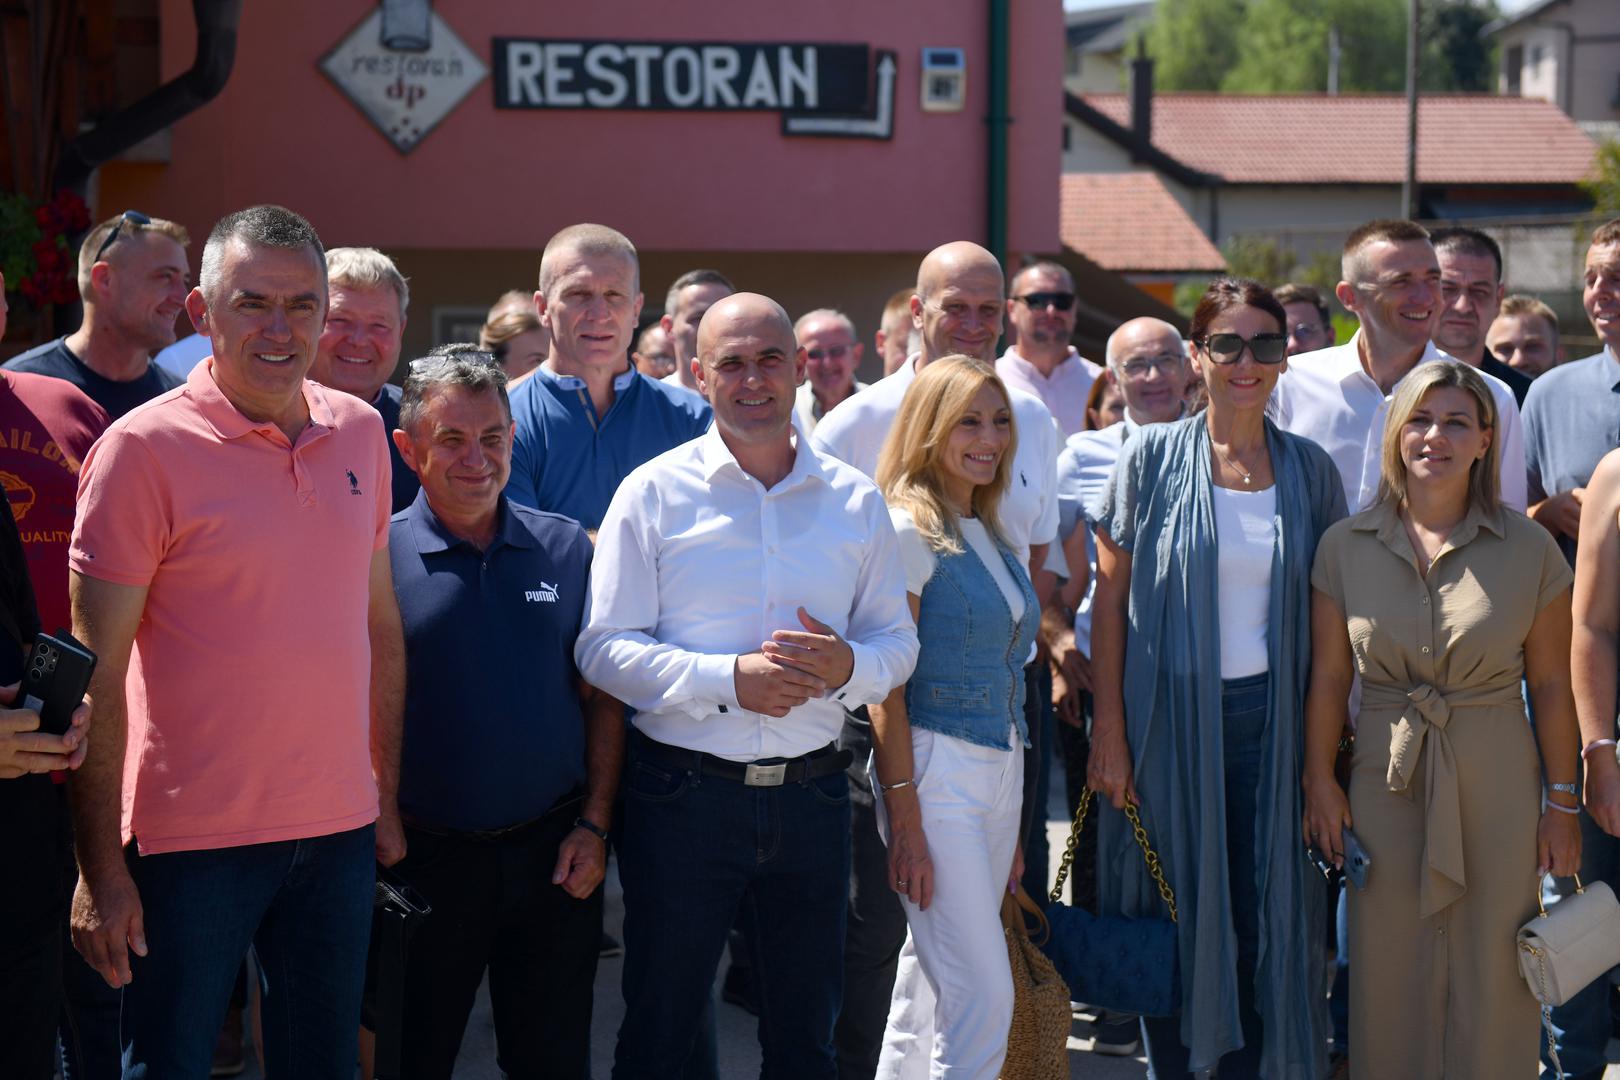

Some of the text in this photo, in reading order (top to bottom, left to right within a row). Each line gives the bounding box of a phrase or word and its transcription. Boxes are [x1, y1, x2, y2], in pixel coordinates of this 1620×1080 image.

[352, 55, 463, 77] restoran
[506, 41, 818, 107] RESTORAN
[386, 76, 426, 109] dp
[20, 530, 71, 543] UALITY
[524, 590, 556, 603] PUMA
